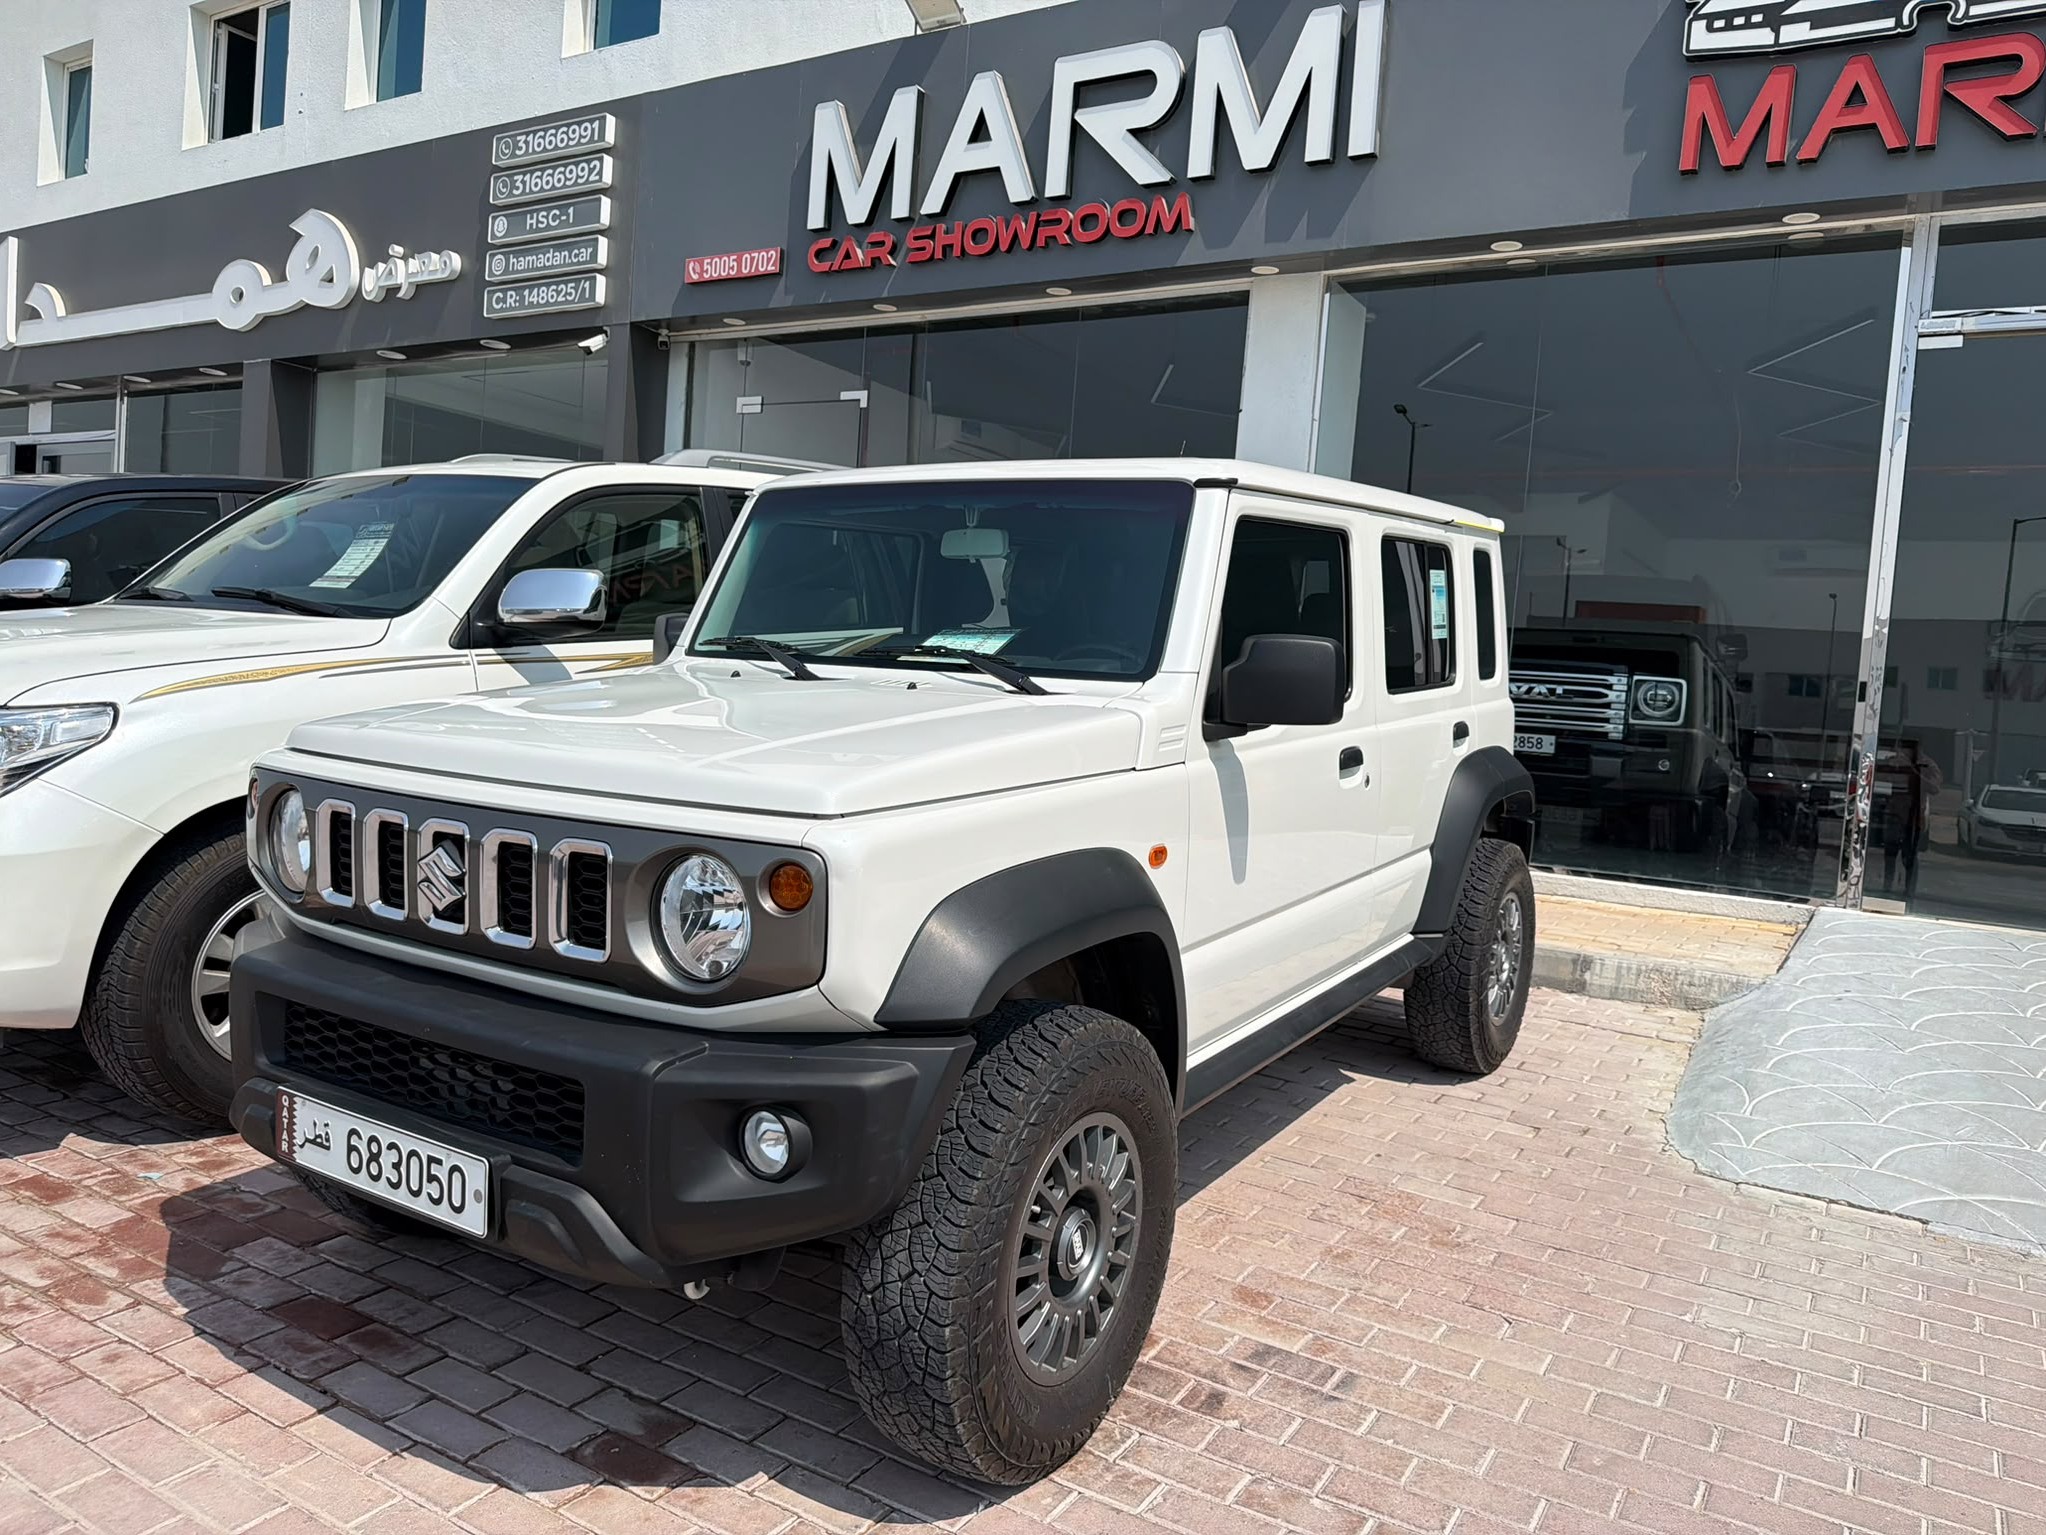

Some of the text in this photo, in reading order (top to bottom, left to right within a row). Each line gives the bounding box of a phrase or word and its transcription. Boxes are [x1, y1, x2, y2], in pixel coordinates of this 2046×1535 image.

[806, 0, 1388, 232] MARMI
[1679, 32, 2046, 176] MAR
[515, 120, 600, 155] 31666991
[512, 160, 600, 195] 31666992
[526, 206, 575, 230] HSC-1
[807, 192, 1195, 273] CAR SHOWROOM
[362, 244, 462, 303] معرض
[509, 247, 593, 271] hamadan.car
[703, 250, 776, 278] 5005 0702
[492, 280, 591, 309] C.R: 148625/1
[280, 1094, 290, 1153] QATAR
[299, 1117, 332, 1151] قطر
[346, 1127, 467, 1215] 683050
